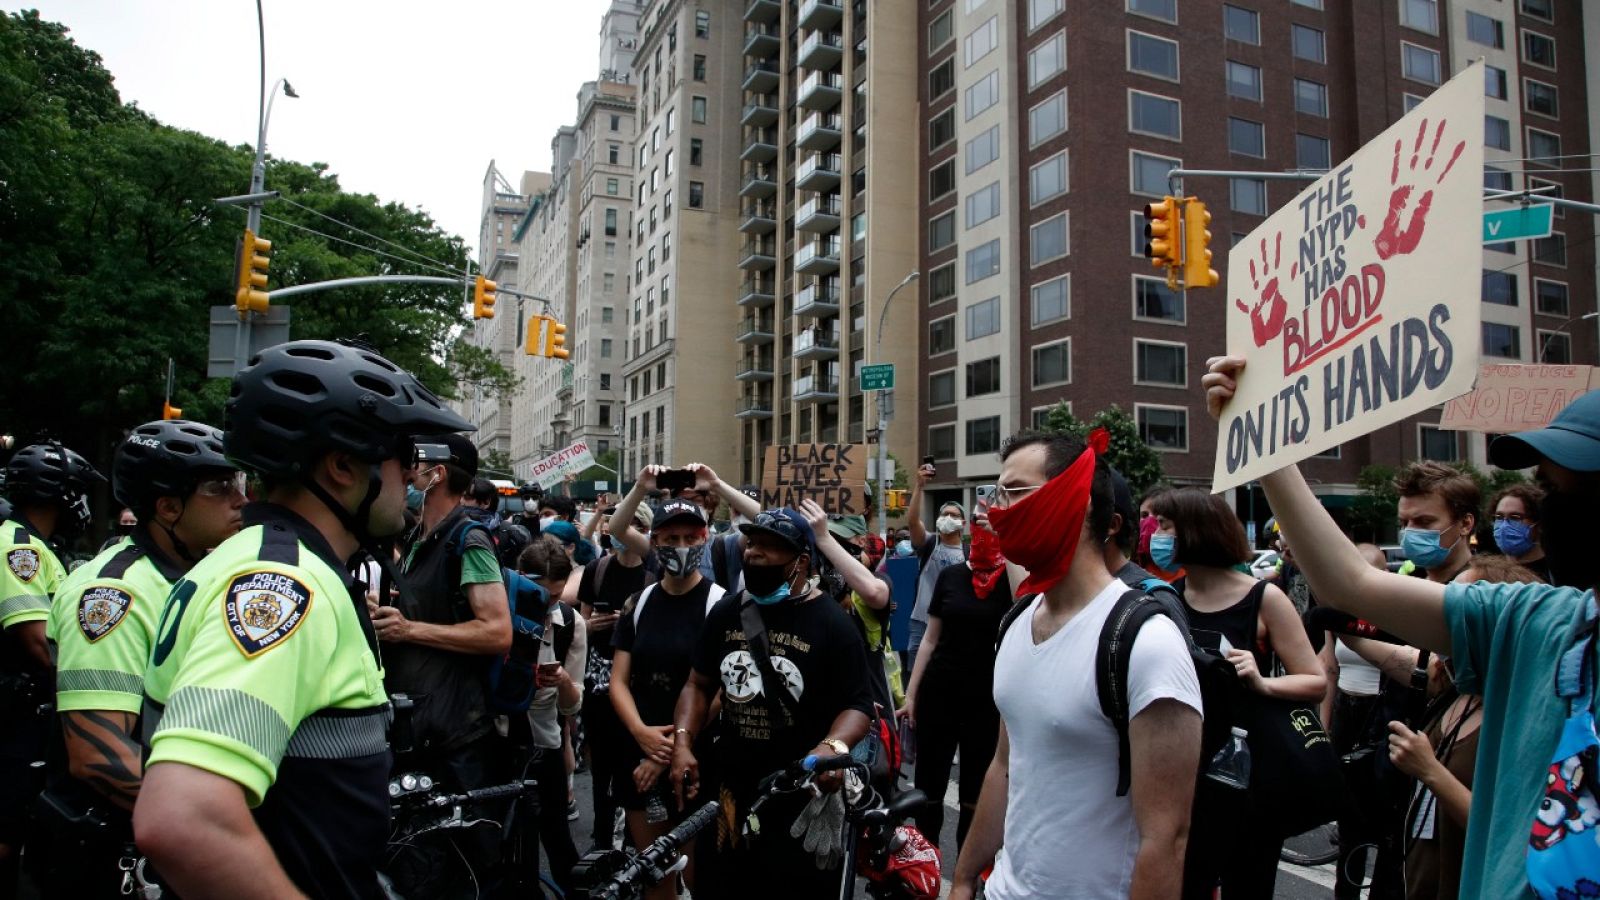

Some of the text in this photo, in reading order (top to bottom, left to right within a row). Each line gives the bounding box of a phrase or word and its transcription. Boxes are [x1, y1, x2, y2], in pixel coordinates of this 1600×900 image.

[1299, 165, 1353, 233] THE
[1300, 203, 1358, 275] NYPD
[1303, 245, 1346, 307] HAS
[1283, 262, 1386, 377] BLOOD
[1226, 303, 1454, 474] ON ITS HANDS
[1446, 387, 1501, 421] NO
[127, 435, 161, 449] POLICE
[533, 442, 587, 476] EDUCATION
[777, 444, 853, 465] BLACK
[776, 464, 848, 487] LIVES
[763, 486, 856, 514] MATTER
[232, 581, 305, 604] DEPARTMENT
[253, 574, 295, 588] POLICE
[227, 602, 246, 637] CITY OF
[258, 611, 301, 646] NEW YORK
